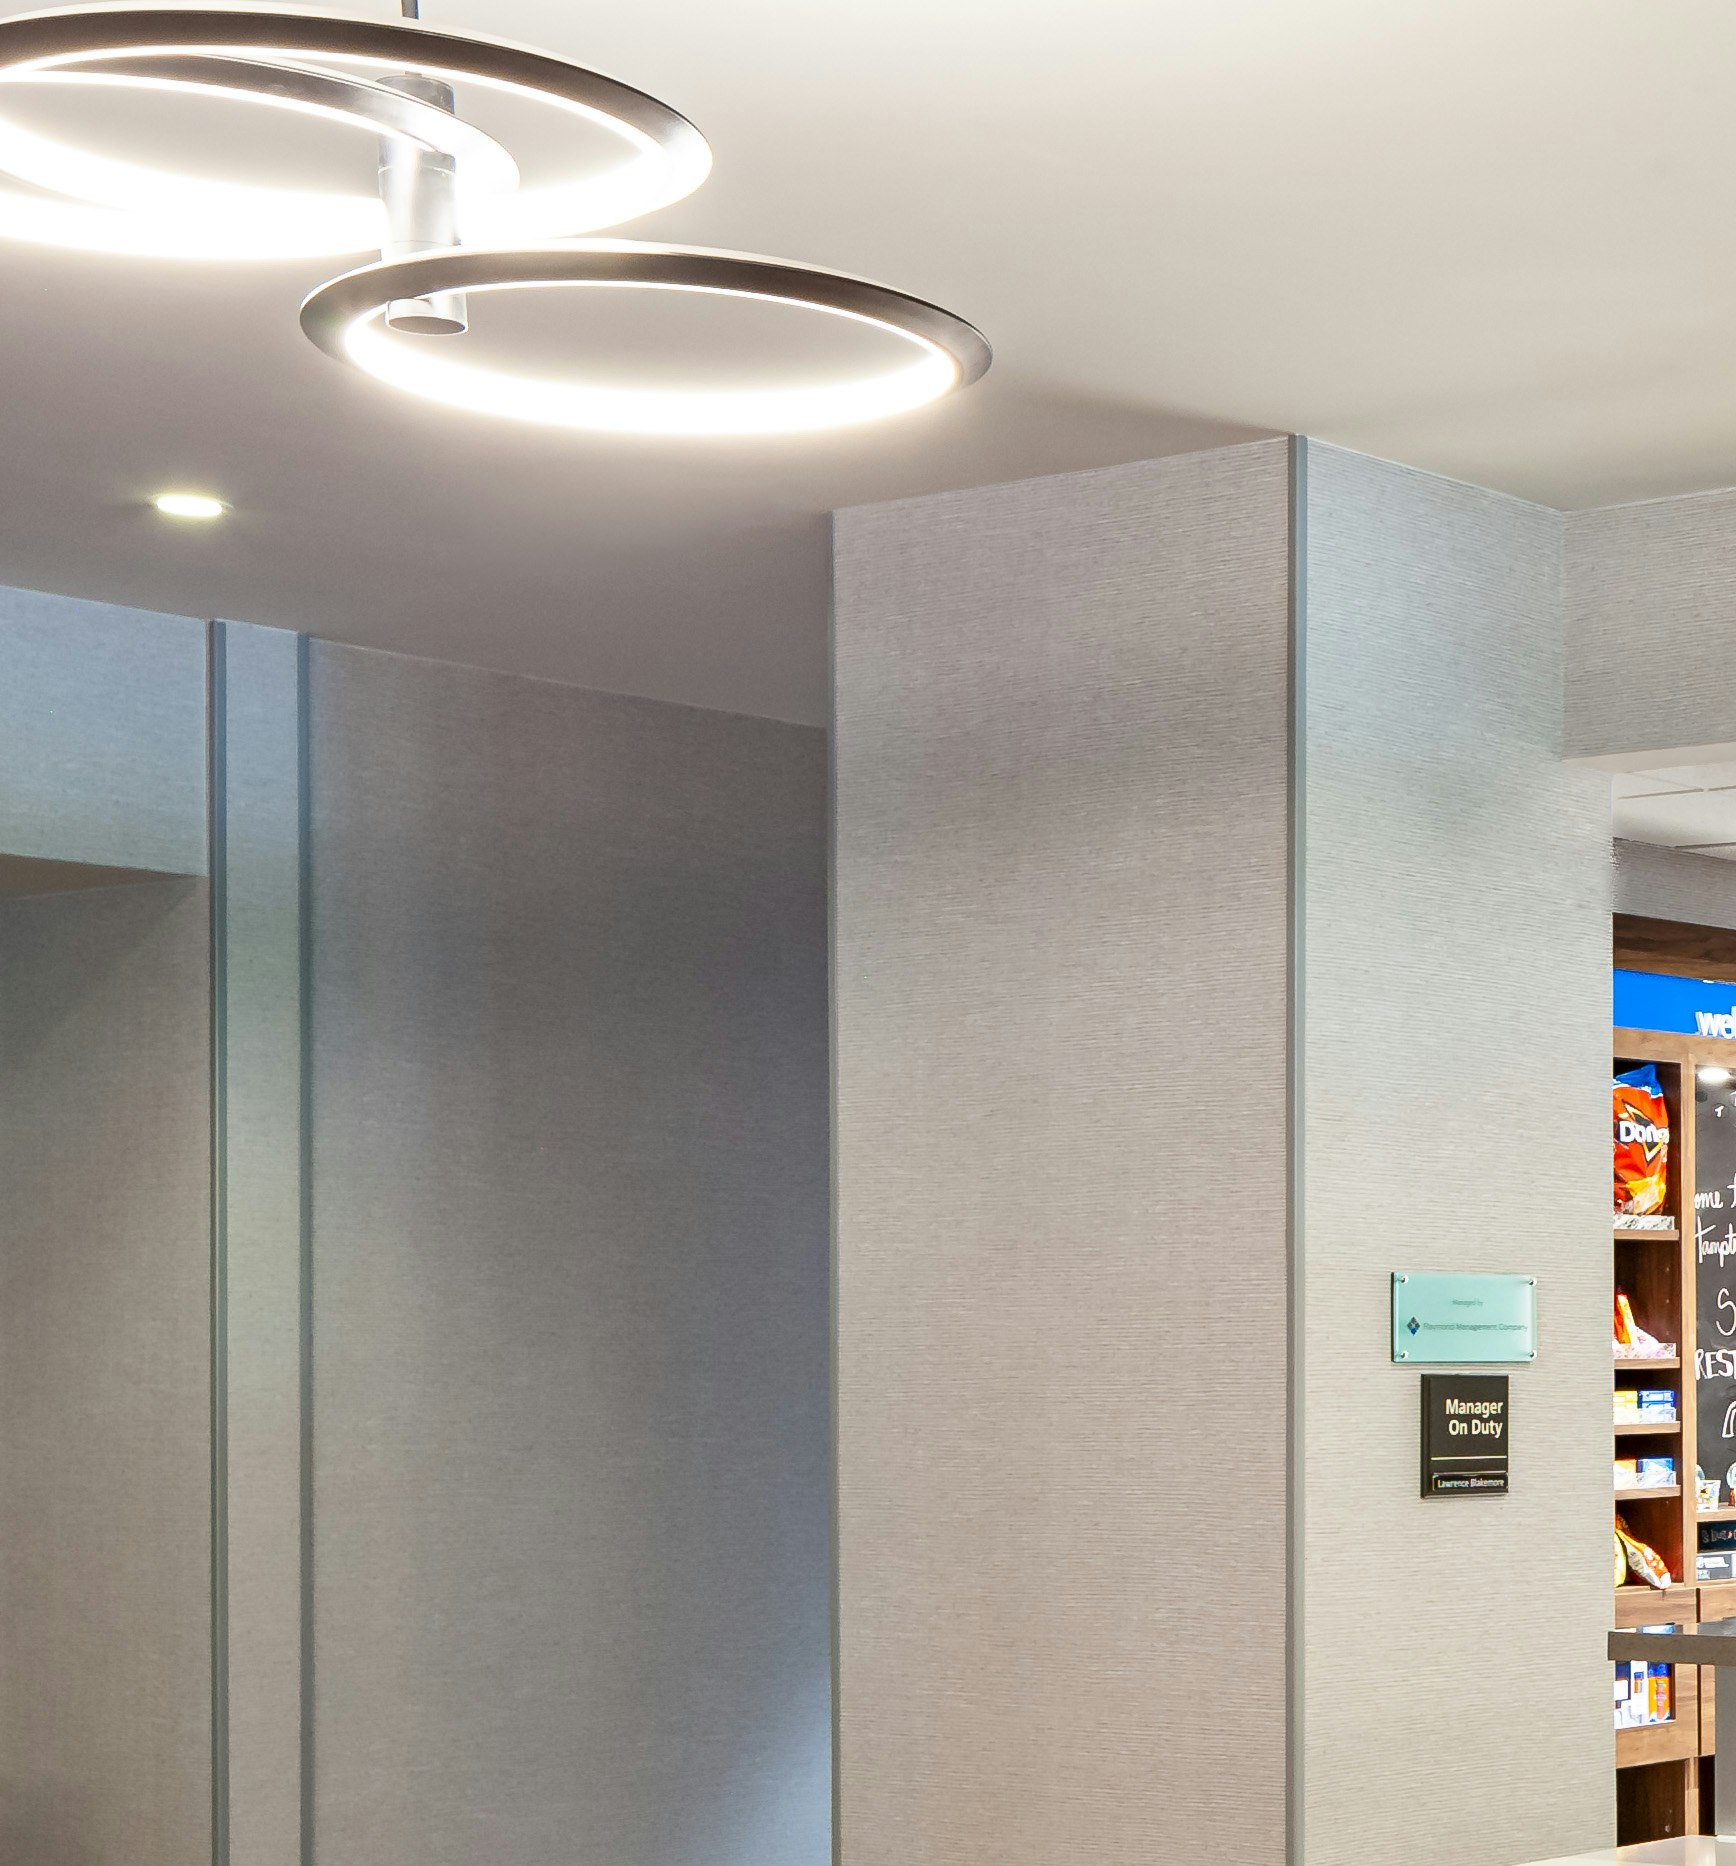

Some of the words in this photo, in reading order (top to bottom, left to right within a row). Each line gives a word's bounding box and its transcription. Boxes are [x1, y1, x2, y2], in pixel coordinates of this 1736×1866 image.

[1456, 1322, 1498, 1331] Management
[1446, 1398, 1504, 1418] Manager
[1448, 1419, 1468, 1435] On
[1471, 1419, 1503, 1438] Duty
